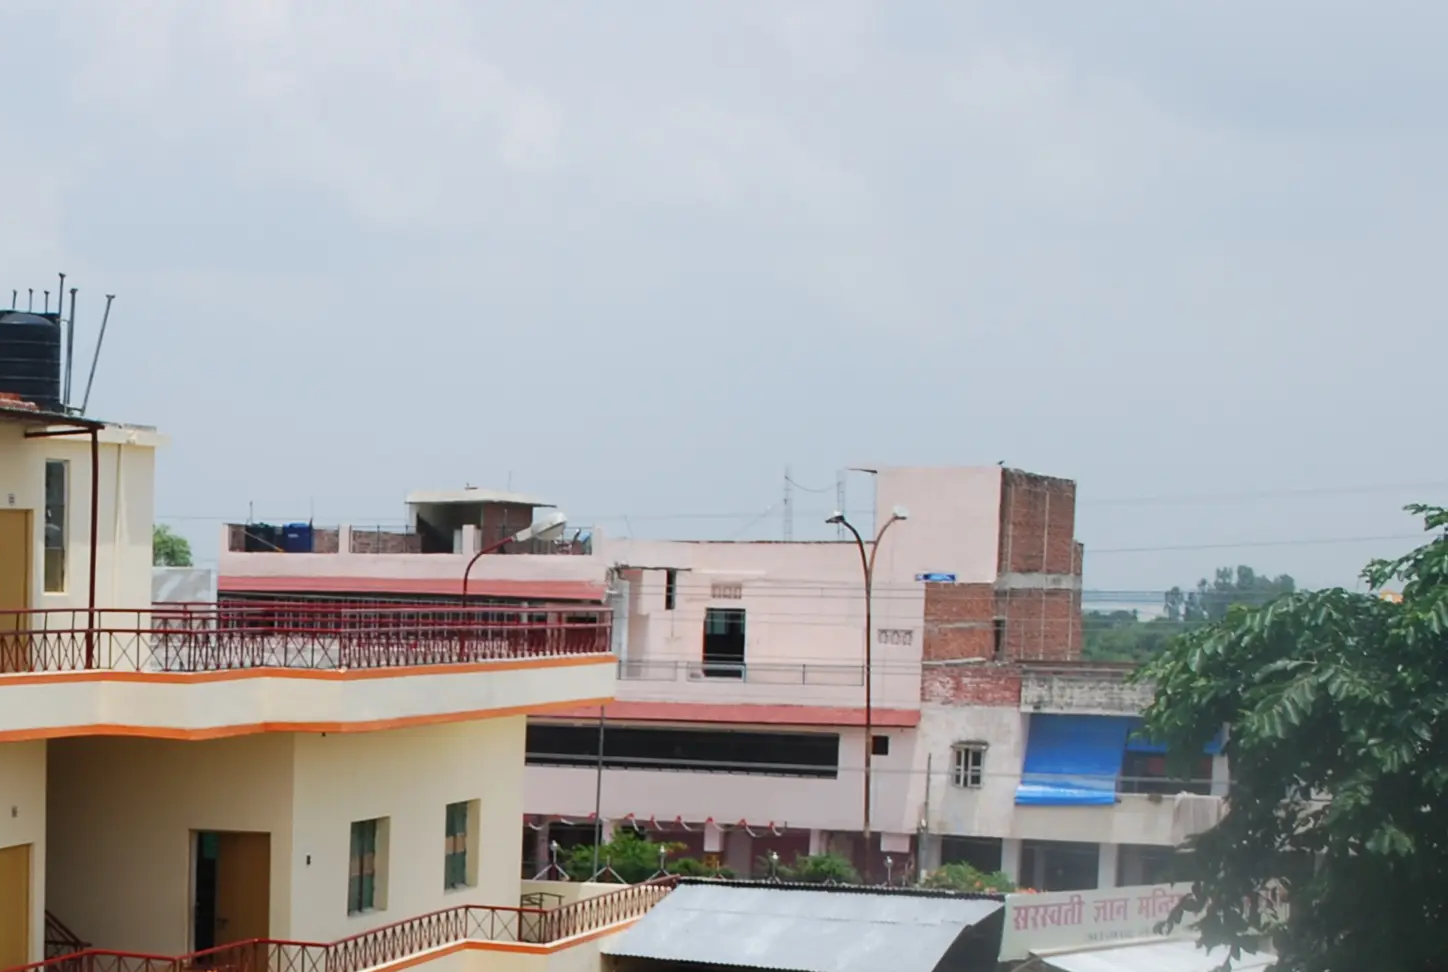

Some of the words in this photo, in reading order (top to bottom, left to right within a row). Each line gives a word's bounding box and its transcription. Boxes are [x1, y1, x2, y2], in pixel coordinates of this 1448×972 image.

[1013, 894, 1084, 931] सरस्वती
[1092, 898, 1128, 924] ज्ञान
[1138, 888, 1184, 920] मन्दि
